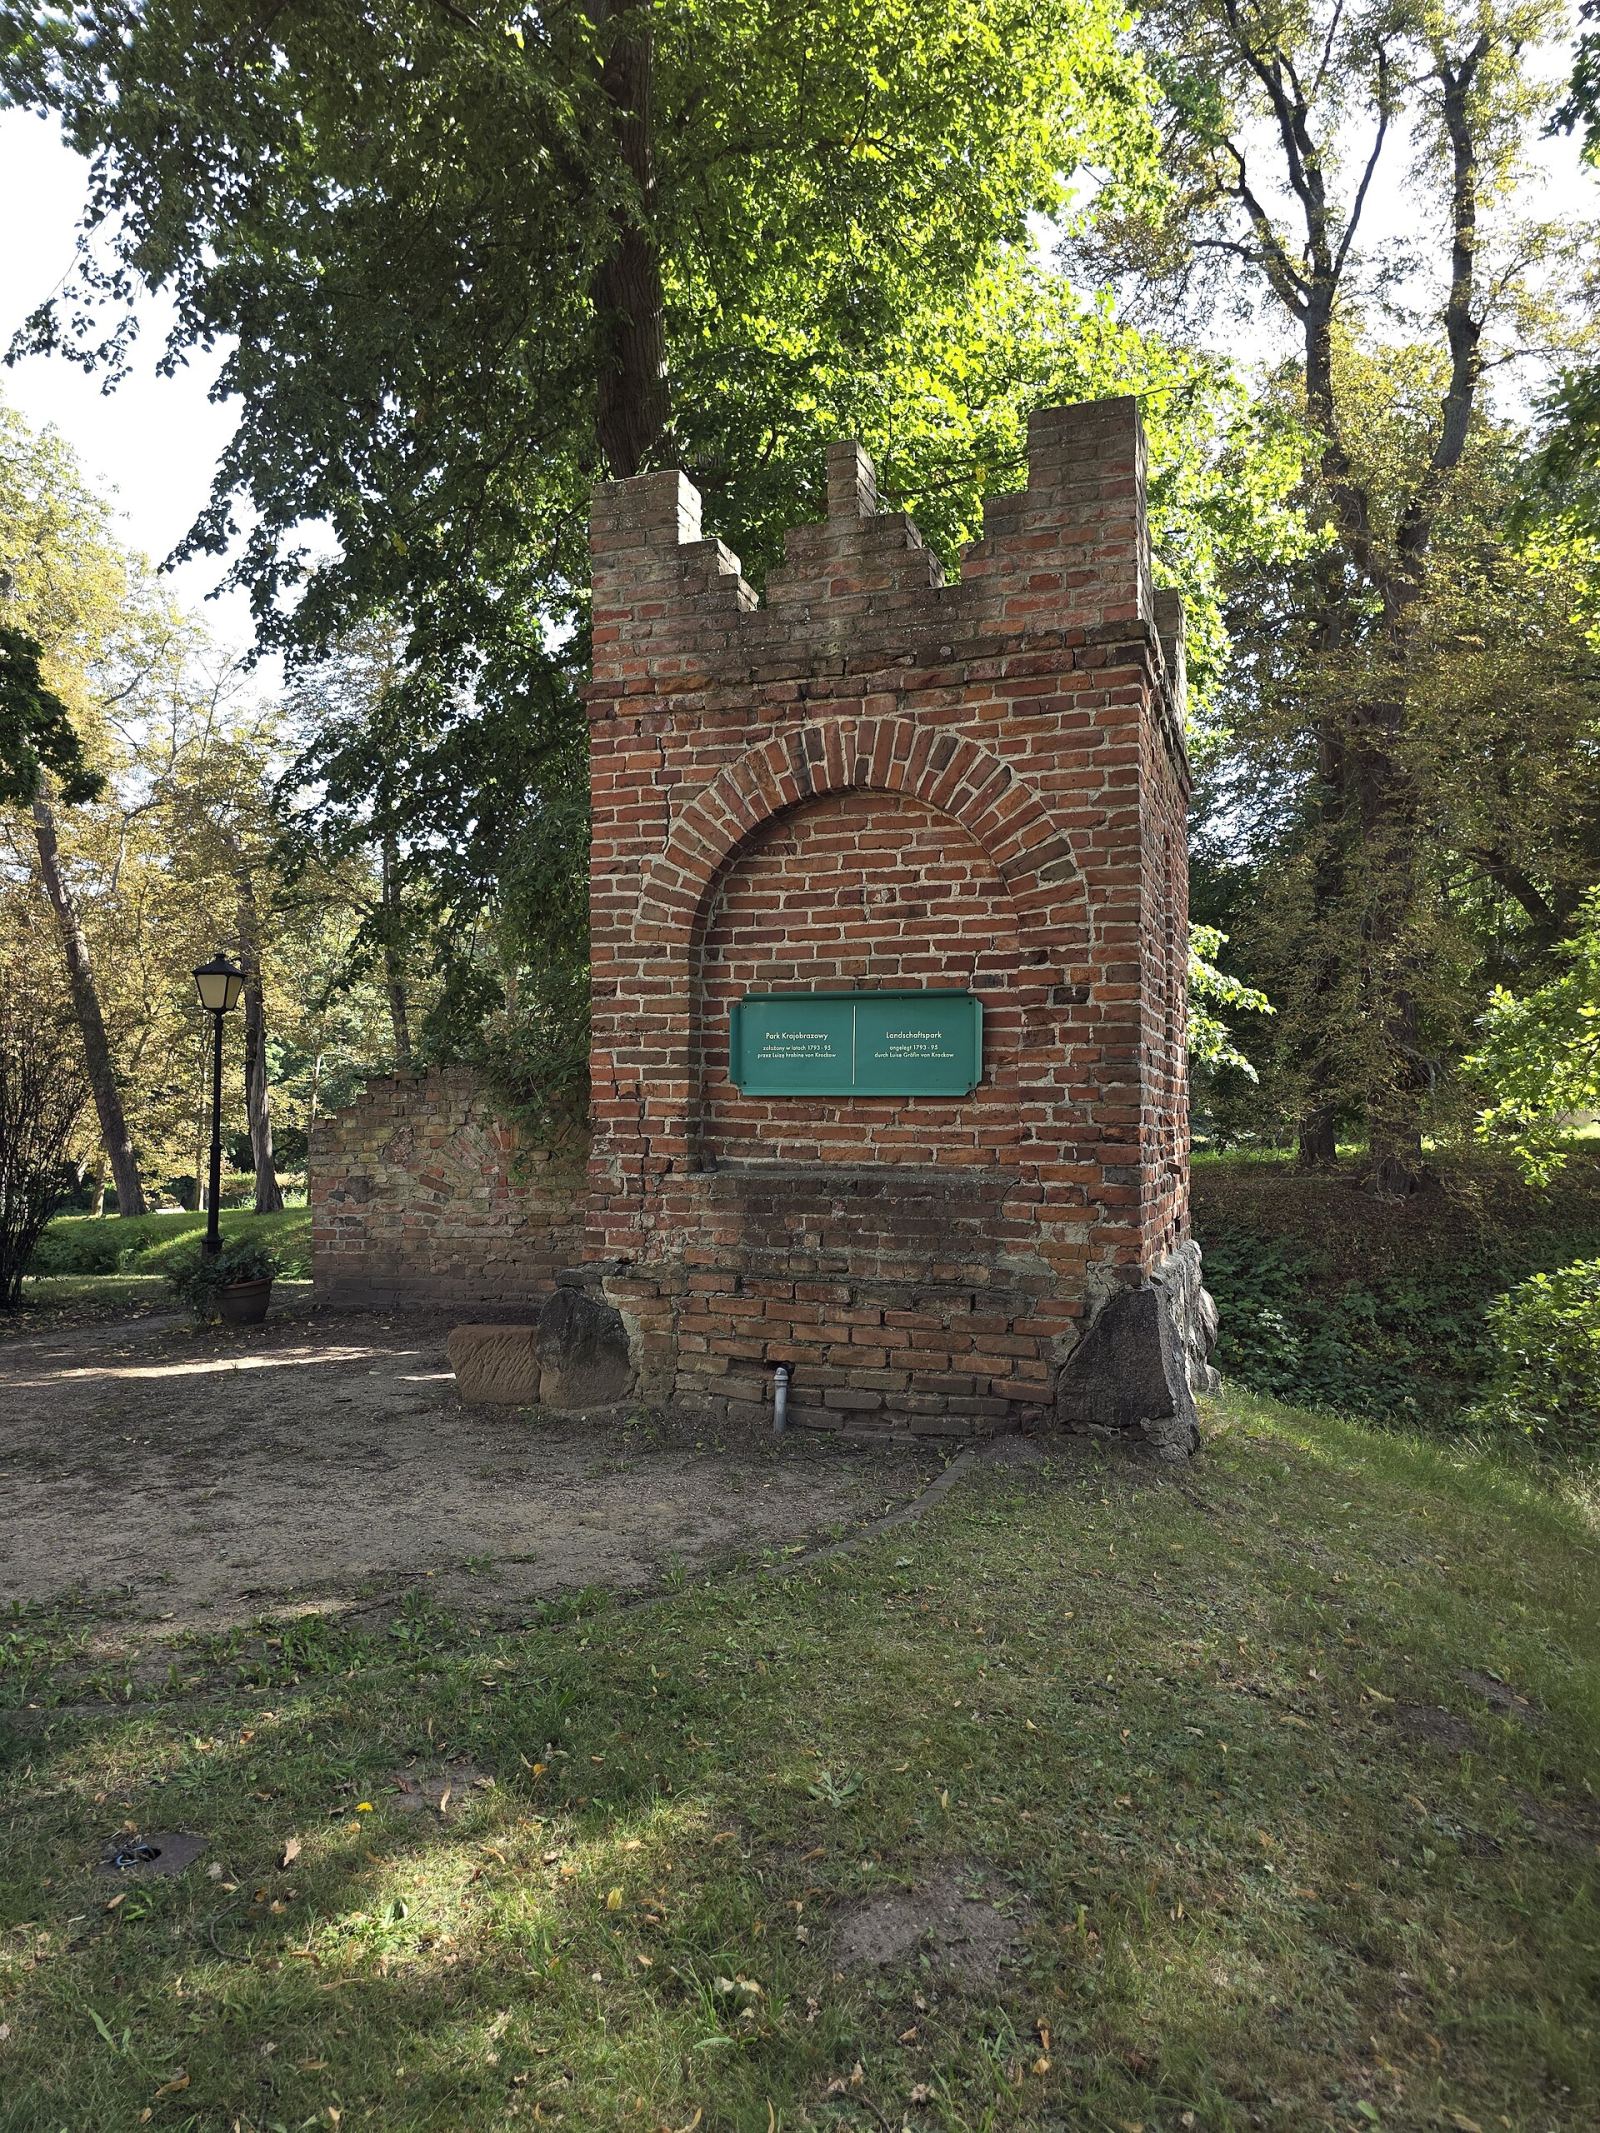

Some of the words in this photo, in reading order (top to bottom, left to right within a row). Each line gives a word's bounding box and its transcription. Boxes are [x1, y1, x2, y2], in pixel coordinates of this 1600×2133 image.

[766, 1032, 780, 1040] Park
[782, 1032, 828, 1040] Krajobrazowy
[886, 1031, 942, 1040] Landschaftspark
[890, 1044, 912, 1052] angelegt
